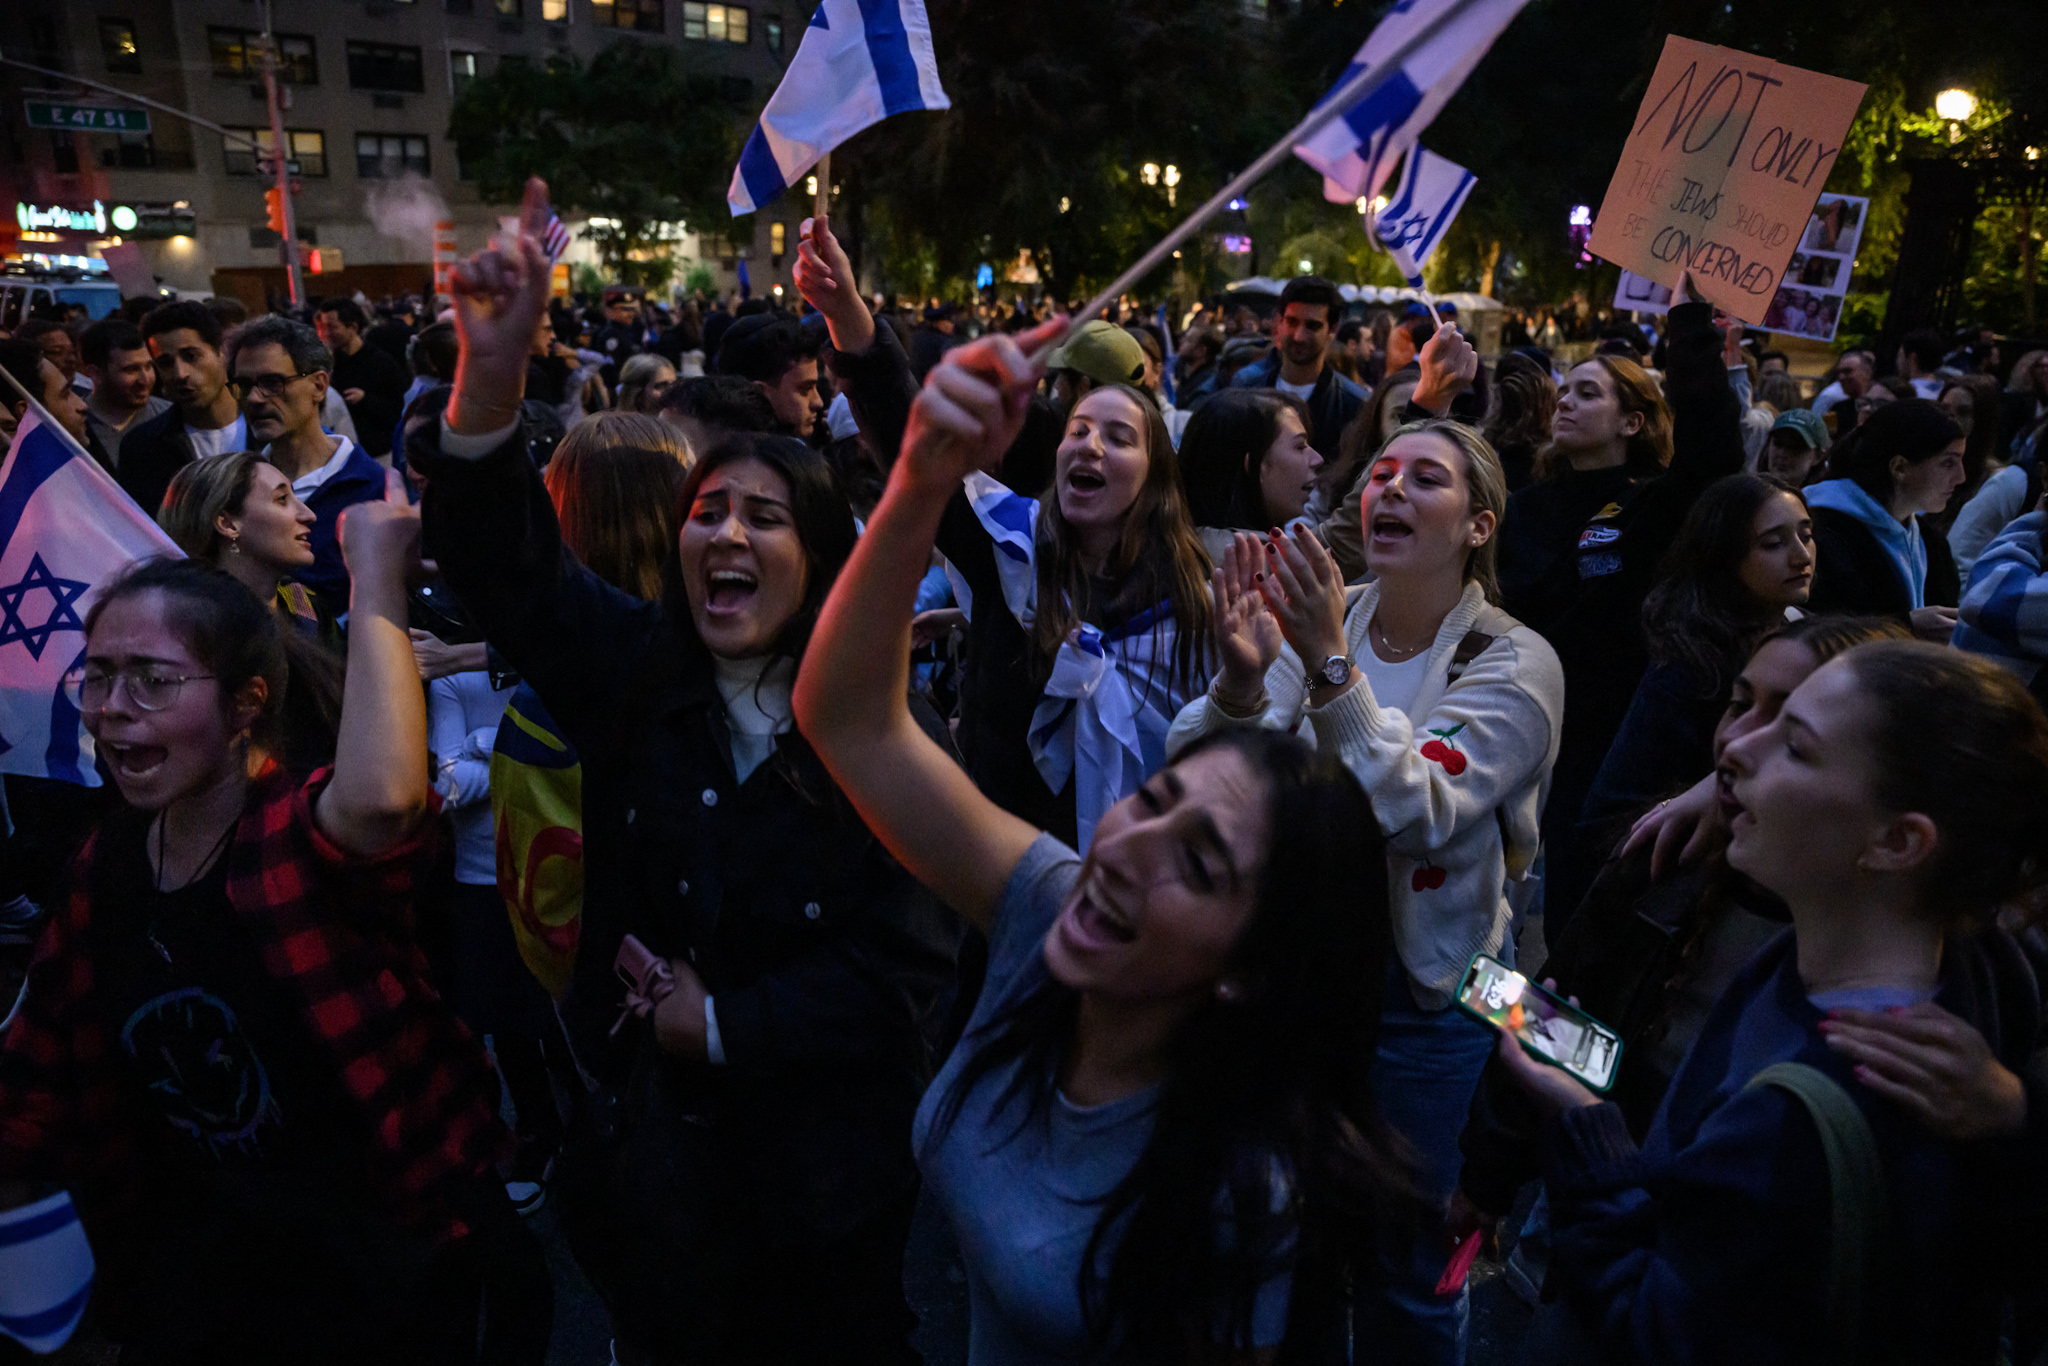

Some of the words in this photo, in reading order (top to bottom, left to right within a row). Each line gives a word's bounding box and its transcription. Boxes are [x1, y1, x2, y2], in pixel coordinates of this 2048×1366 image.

[52, 107, 65, 124] E
[71, 109, 98, 126] 47
[1637, 61, 1783, 168] NOT
[1751, 126, 1838, 188] ONLY
[1625, 159, 1672, 206] THE
[1670, 177, 1725, 220] JEWS
[1727, 203, 1790, 250] SHOULD
[1621, 212, 1649, 240] BE
[1650, 225, 1774, 295] CONCERNED
